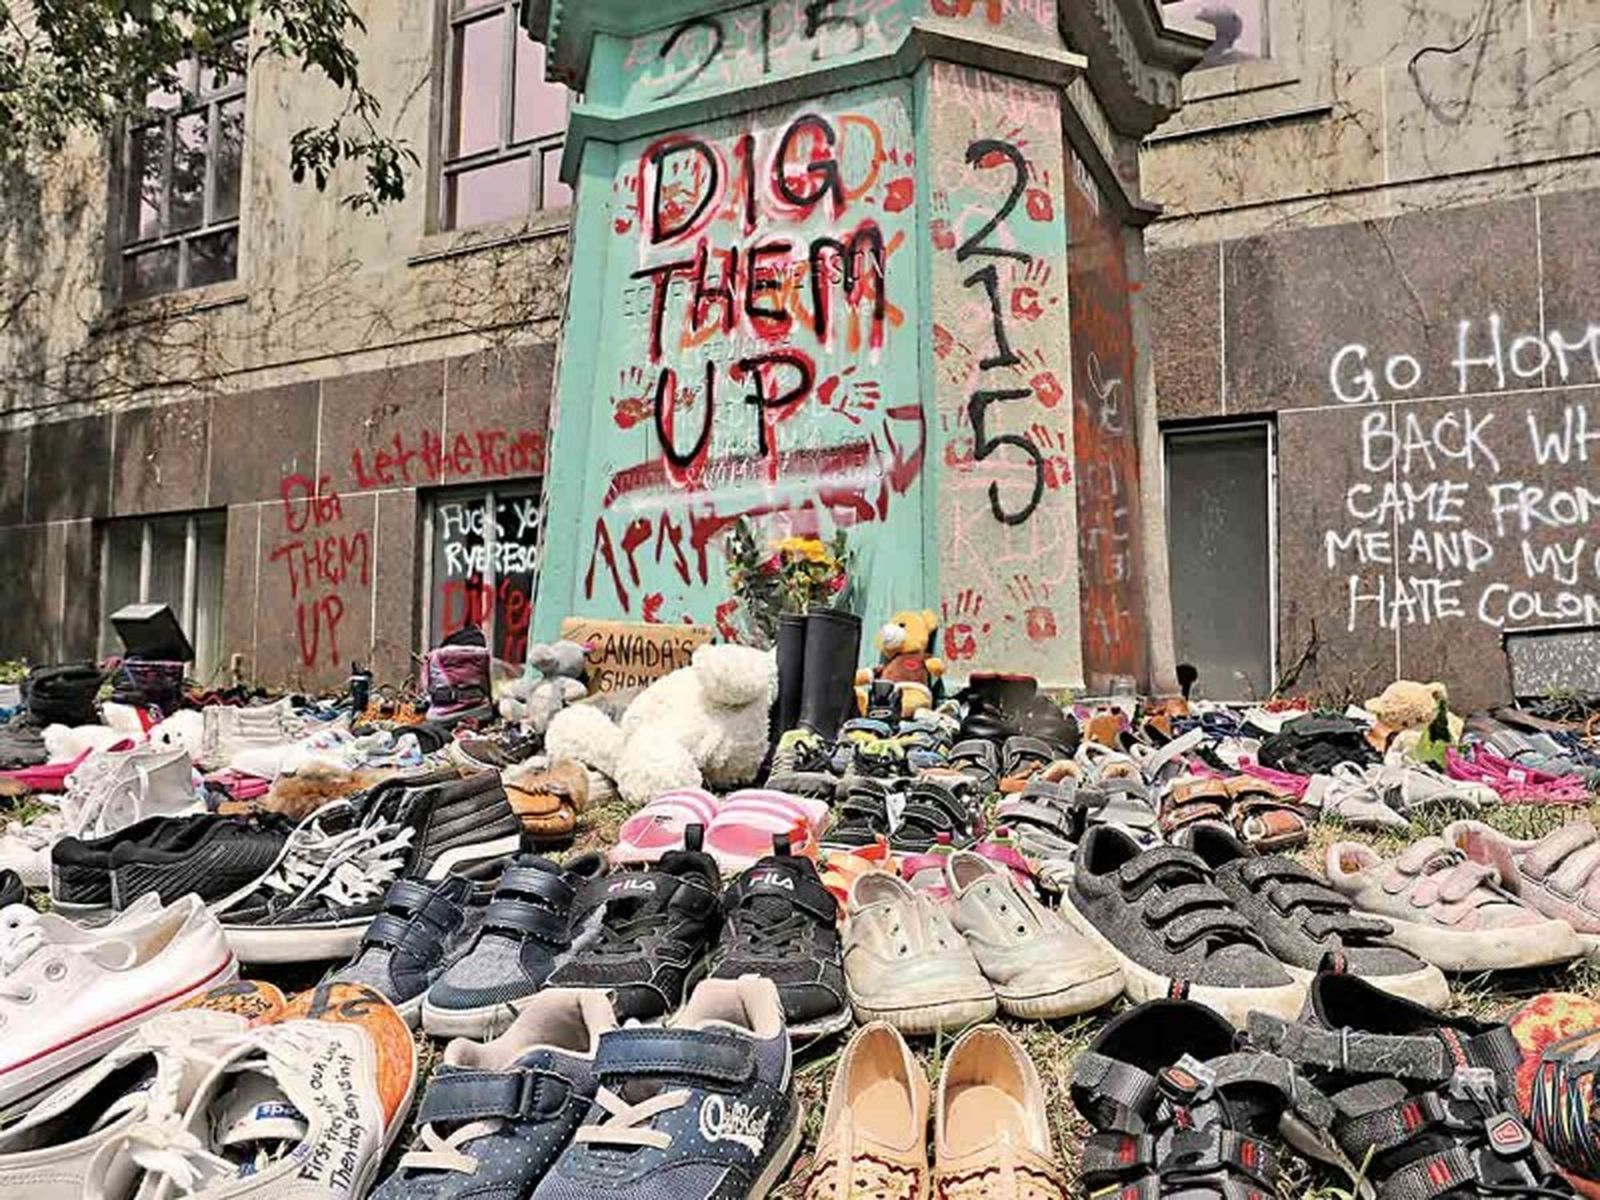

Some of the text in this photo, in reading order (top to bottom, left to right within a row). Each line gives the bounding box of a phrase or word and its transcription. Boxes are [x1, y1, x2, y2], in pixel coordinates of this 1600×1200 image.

[648, 112, 843, 244] DIG
[630, 228, 886, 362] THEM
[654, 351, 814, 466] UP
[1361, 410, 1500, 473] BACK
[440, 503, 506, 540] FUCK
[1347, 480, 1469, 524] CAME
[269, 532, 369, 599] THEM
[1325, 529, 1392, 570] ME
[1408, 529, 1494, 573] AND
[1522, 538, 1586, 585] MY
[296, 594, 344, 667] UP
[1347, 575, 1466, 632] HATE
[586, 632, 695, 672] CANADA'S
[607, 878, 657, 893] FILA
[749, 873, 795, 892] FILA
[297, 1141, 332, 1181] First
[329, 1150, 358, 1192] Then
